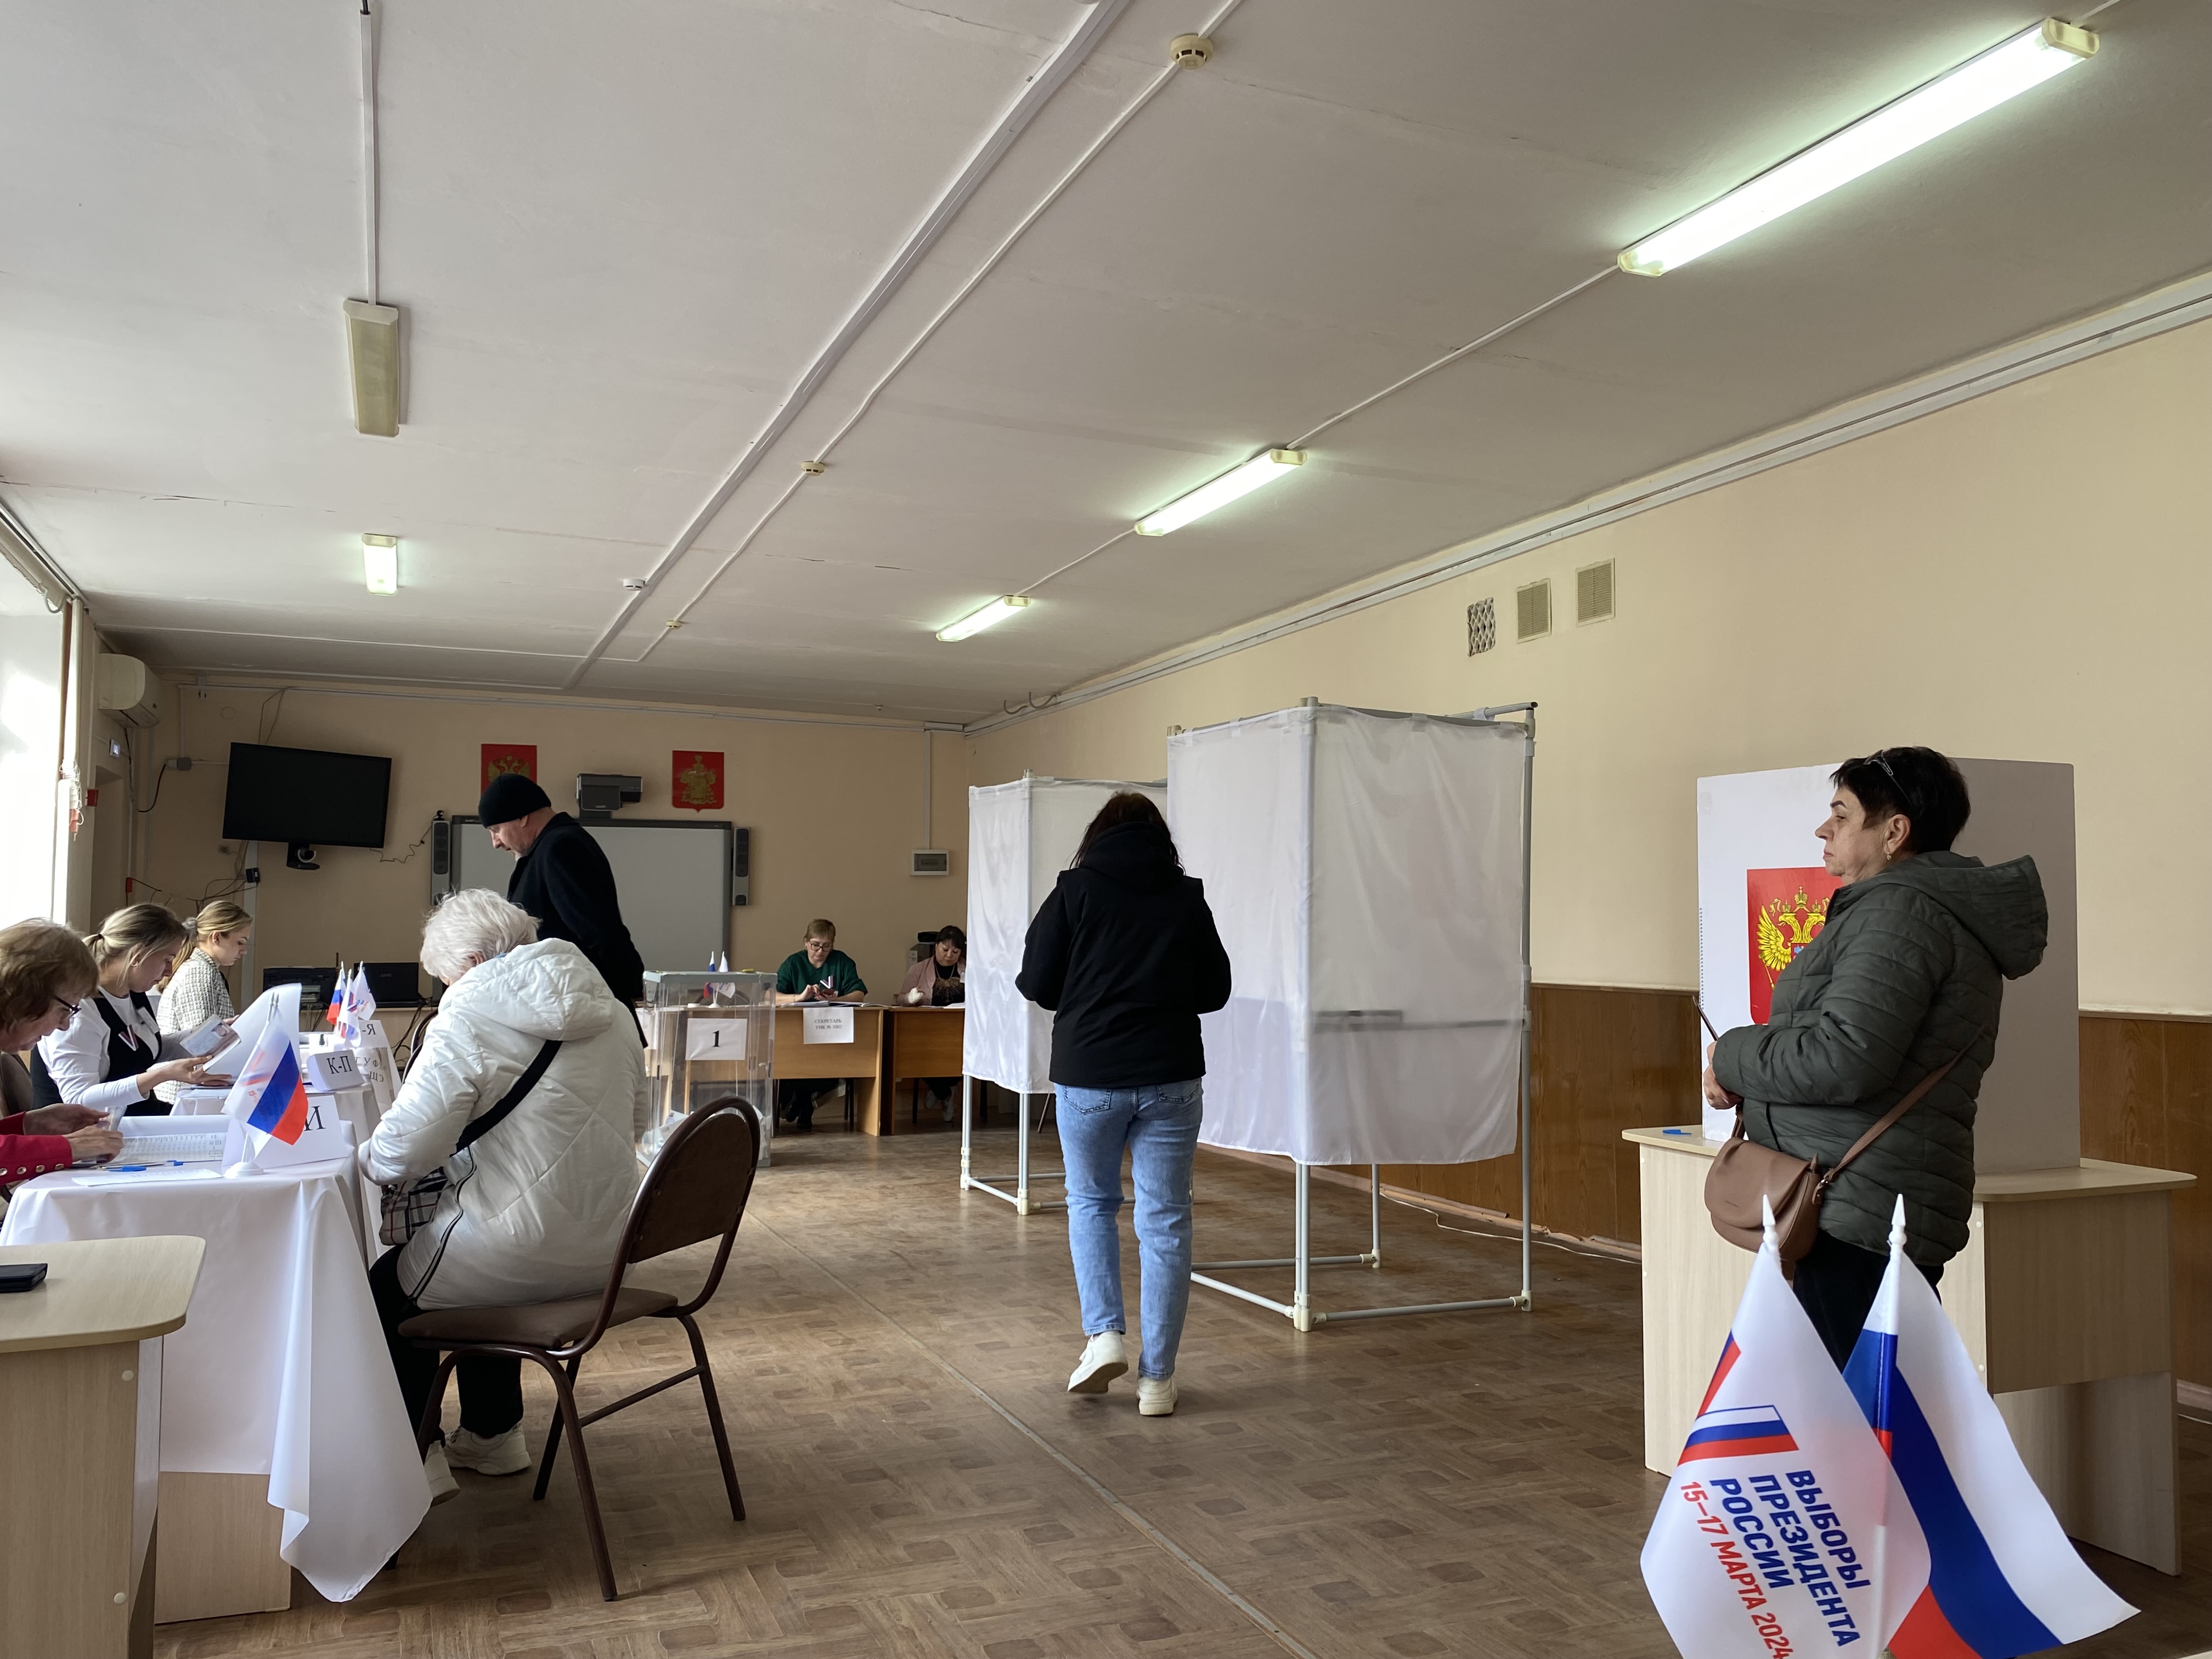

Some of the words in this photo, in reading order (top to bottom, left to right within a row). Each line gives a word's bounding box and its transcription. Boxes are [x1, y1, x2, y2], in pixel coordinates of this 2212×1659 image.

[327, 1056, 352, 1074] К-П
[364, 1057, 371, 1065] У
[712, 1030, 720, 1047] 1
[1709, 1479, 1795, 1589] РОССИИ
[1748, 1475, 1860, 1646] ПРЕЗИДЕНТА
[1786, 1470, 1871, 1589] ВЫБОРЫ
[1710, 1541, 1767, 1610] МАРТА
[1751, 1613, 1793, 1659] 2024
